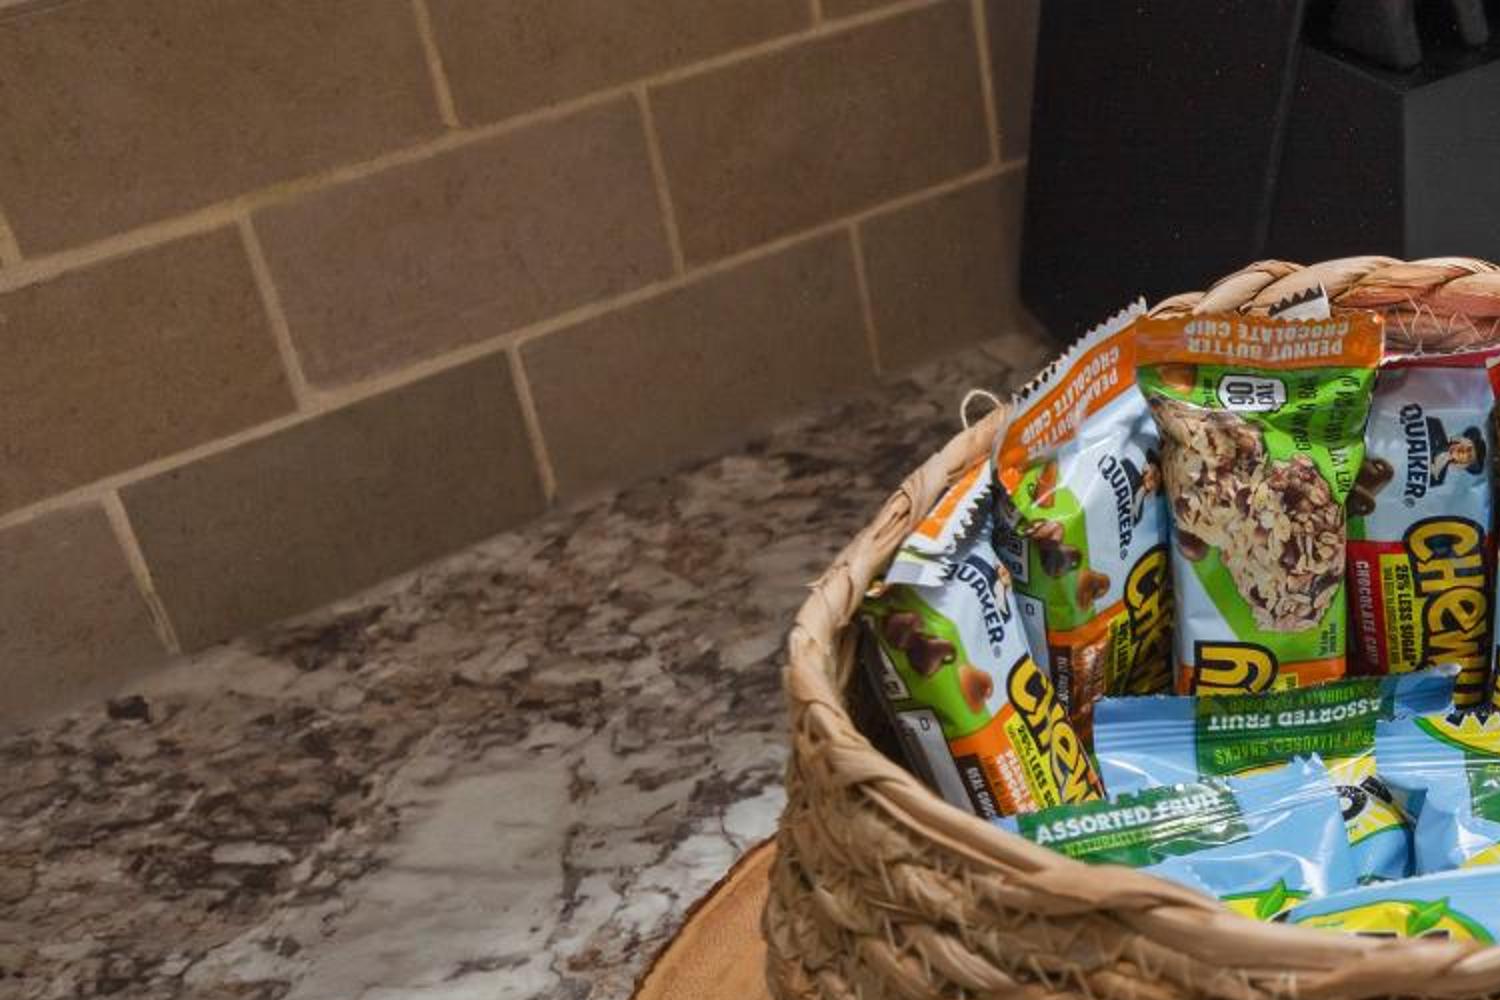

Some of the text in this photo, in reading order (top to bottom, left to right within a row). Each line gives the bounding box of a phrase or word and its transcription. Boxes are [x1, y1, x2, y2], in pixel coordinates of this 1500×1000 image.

[1183, 319, 1349, 345] CHOCOLATE CHIP
[1187, 337, 1343, 362] PEANUT BUTTER
[1225, 381, 1255, 405] 90
[1255, 382, 1276, 405] CAL
[1400, 403, 1429, 498] QUAKER
[1098, 454, 1133, 547] QUAKER
[1354, 560, 1378, 634] CHOCOLATE
[1397, 592, 1414, 621] LESS
[1207, 711, 1272, 731] FRUIT
[1278, 696, 1382, 728] ASSORTED
[1214, 740, 1270, 766] SNACKS
[1036, 805, 1151, 845] ASSORTED
